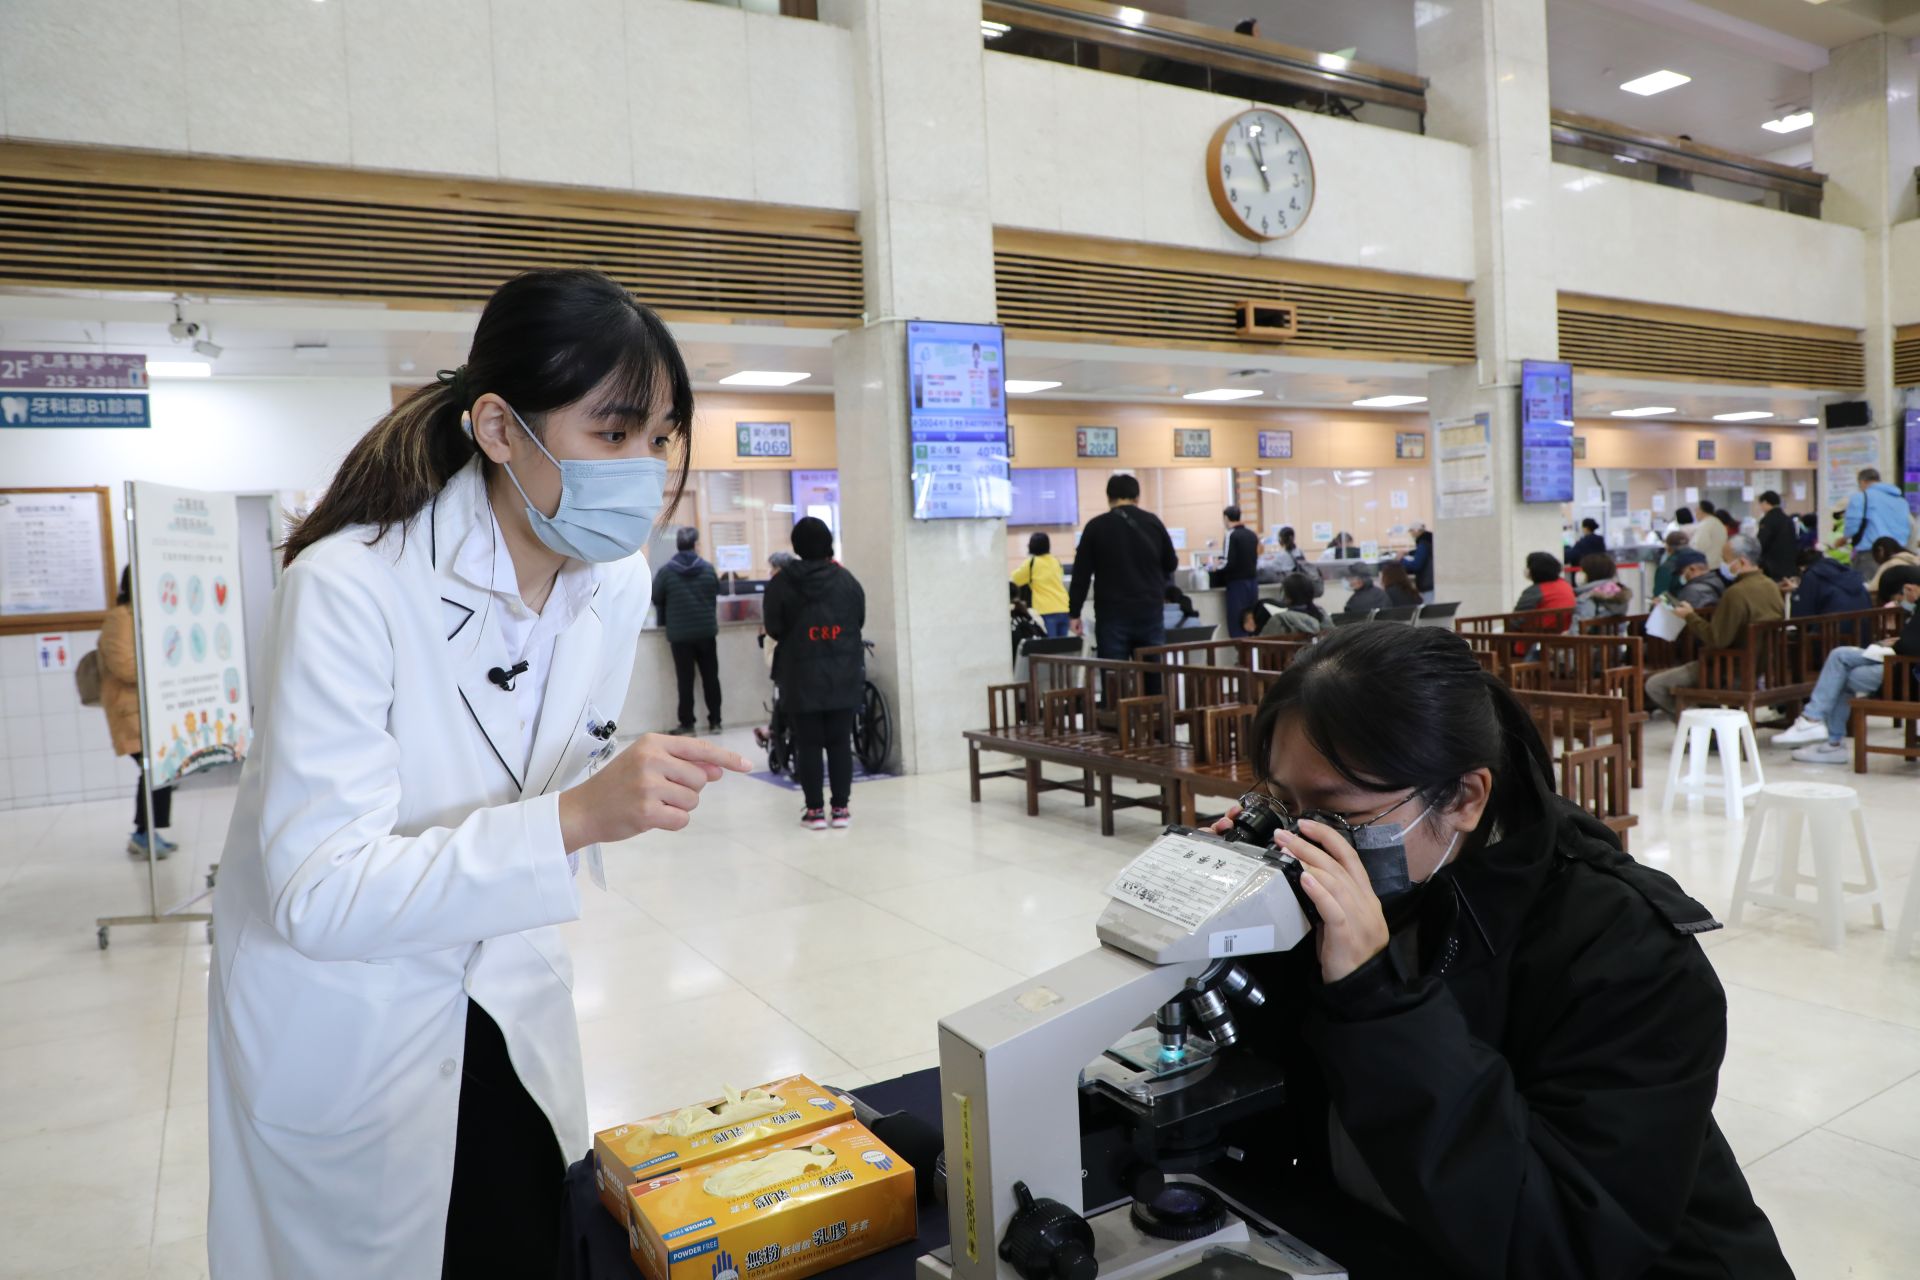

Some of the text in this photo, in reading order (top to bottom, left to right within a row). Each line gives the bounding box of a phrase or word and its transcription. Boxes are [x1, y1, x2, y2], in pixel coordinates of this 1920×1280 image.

[1288, 149, 1299, 165] 2
[1224, 164, 1232, 179] 9
[1292, 172, 1300, 188] 3
[1230, 187, 1238, 203] 8
[1289, 196, 1297, 210] 4
[1244, 205, 1252, 220] 7
[1278, 210, 1286, 225] 5
[1261, 216, 1269, 235] 6
[1, 360, 29, 379] 2F
[754, 440, 788, 454] 4069
[808, 625, 842, 641] C&P
[648, 1179, 661, 1190] S
[684, 1219, 713, 1232] POWDER
[673, 1240, 718, 1260] POWDER FREE
